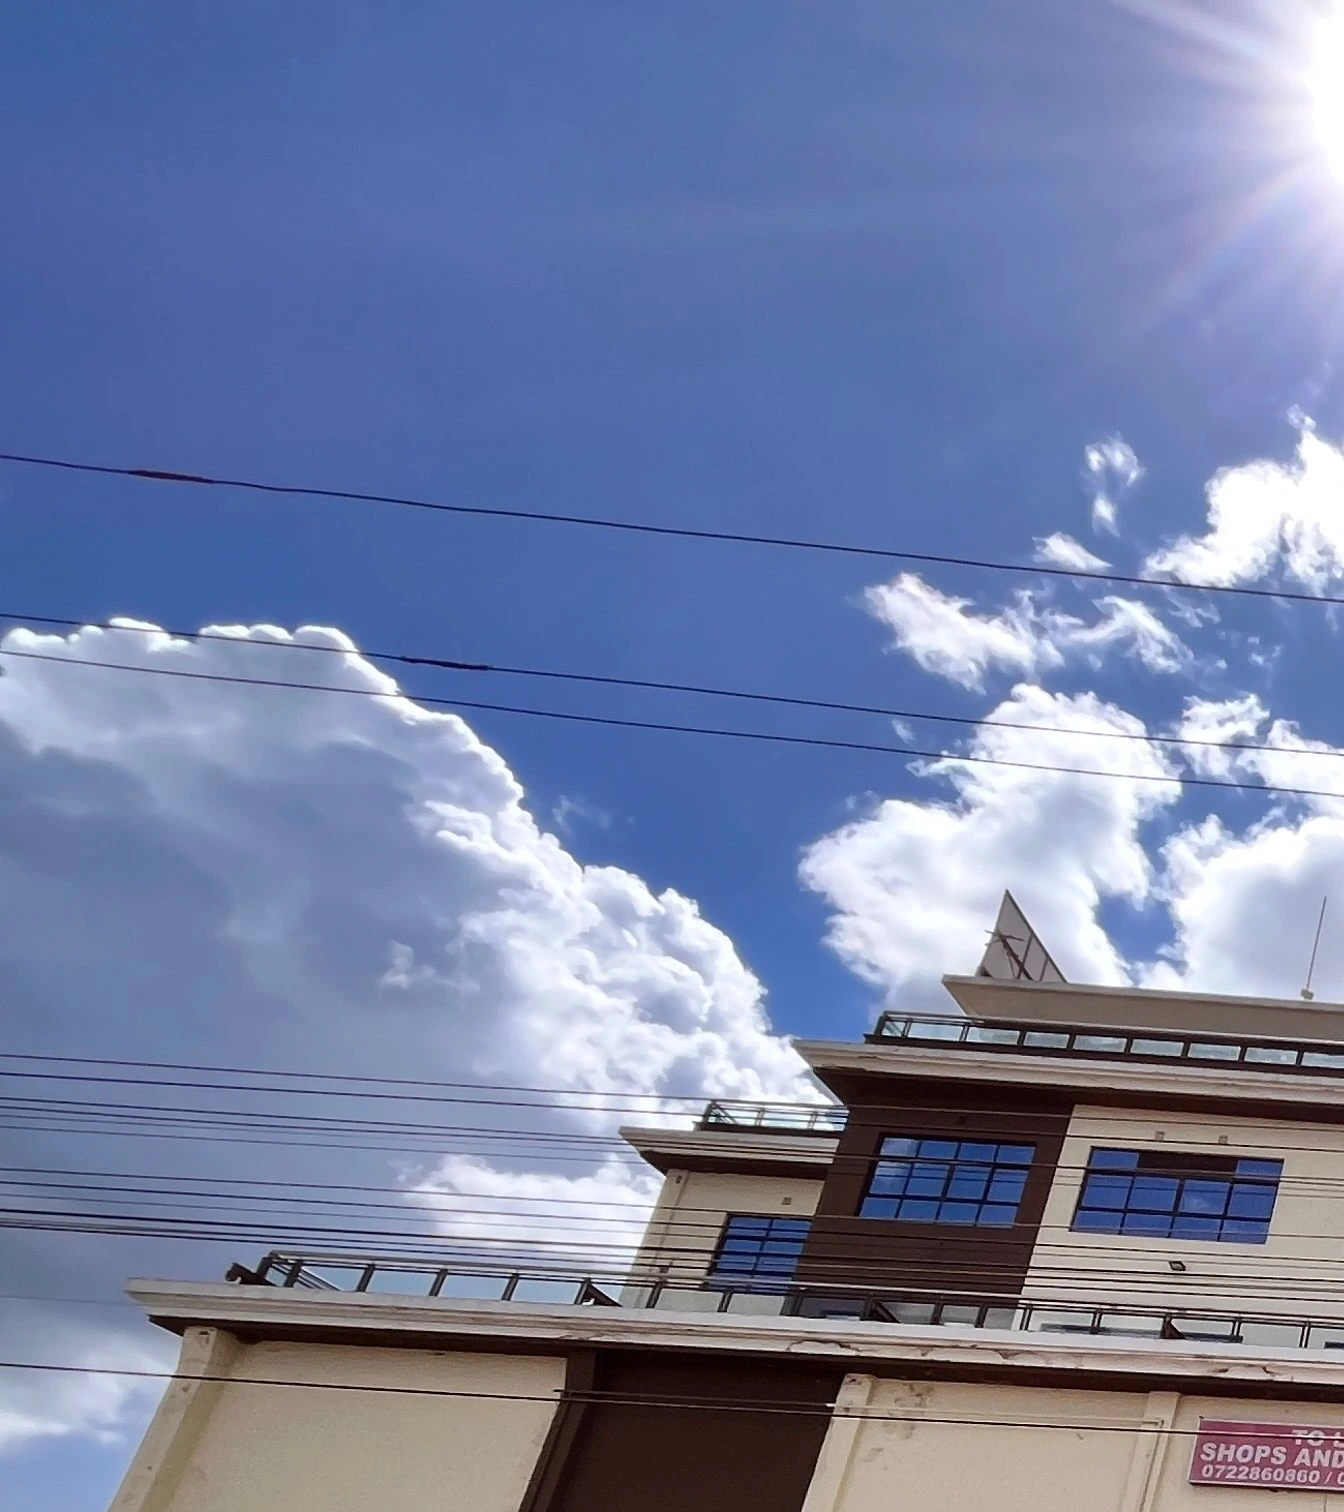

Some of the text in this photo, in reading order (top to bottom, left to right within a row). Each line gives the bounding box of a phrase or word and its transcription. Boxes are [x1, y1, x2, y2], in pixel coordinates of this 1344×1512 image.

[1291, 1429, 1325, 1447] TO
[1200, 1443, 1288, 1465] SHOPS
[1201, 1464, 1321, 1485] 0722860860
